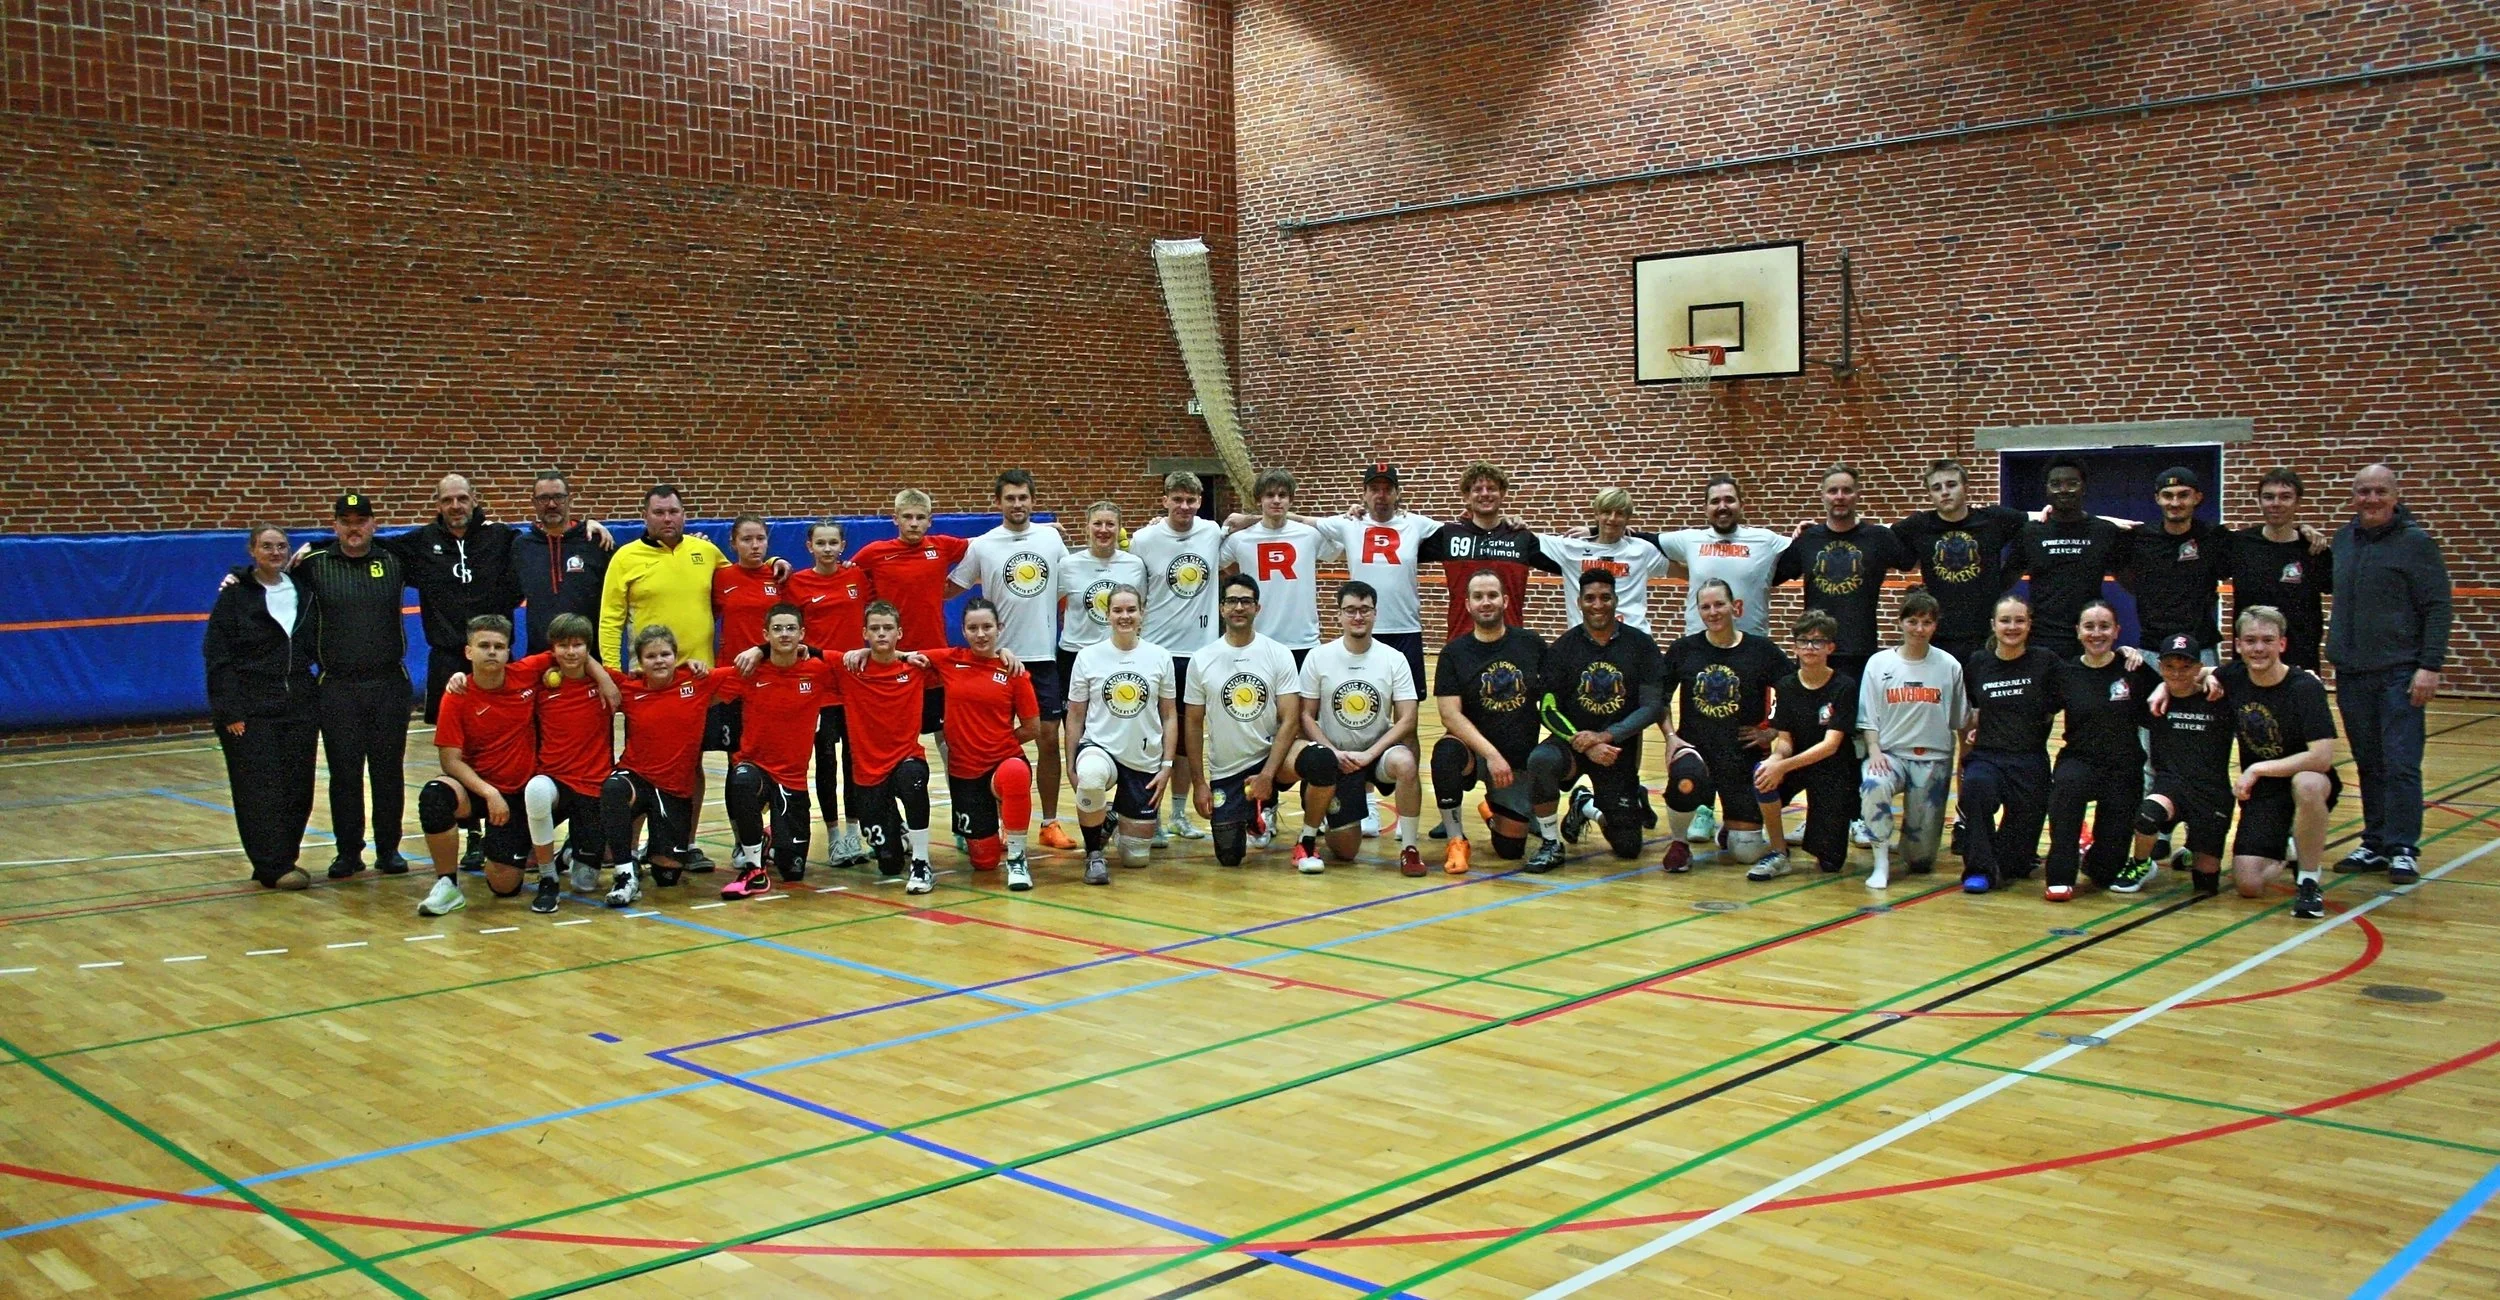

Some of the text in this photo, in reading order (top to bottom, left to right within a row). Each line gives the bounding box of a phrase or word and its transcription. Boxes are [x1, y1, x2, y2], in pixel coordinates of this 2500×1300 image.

[1361, 526, 1402, 565] R
[1374, 535, 1390, 546] 5
[1451, 537, 1471, 557] 69
[1256, 542, 1298, 581] R
[1268, 551, 1286, 563] 5
[764, 586, 777, 594] LTU
[1814, 574, 1863, 595] KRAKENS
[1199, 615, 1208, 628] 10
[800, 682, 811, 691] LTU
[993, 672, 1008, 682] LTU
[680, 686, 694, 695] LTU
[1480, 693, 1526, 712] KRAKENS
[1578, 693, 1625, 715] KRAKENS
[1692, 695, 1739, 718] KRAKENS
[721, 725, 731, 746] 3
[863, 825, 886, 846] 23
